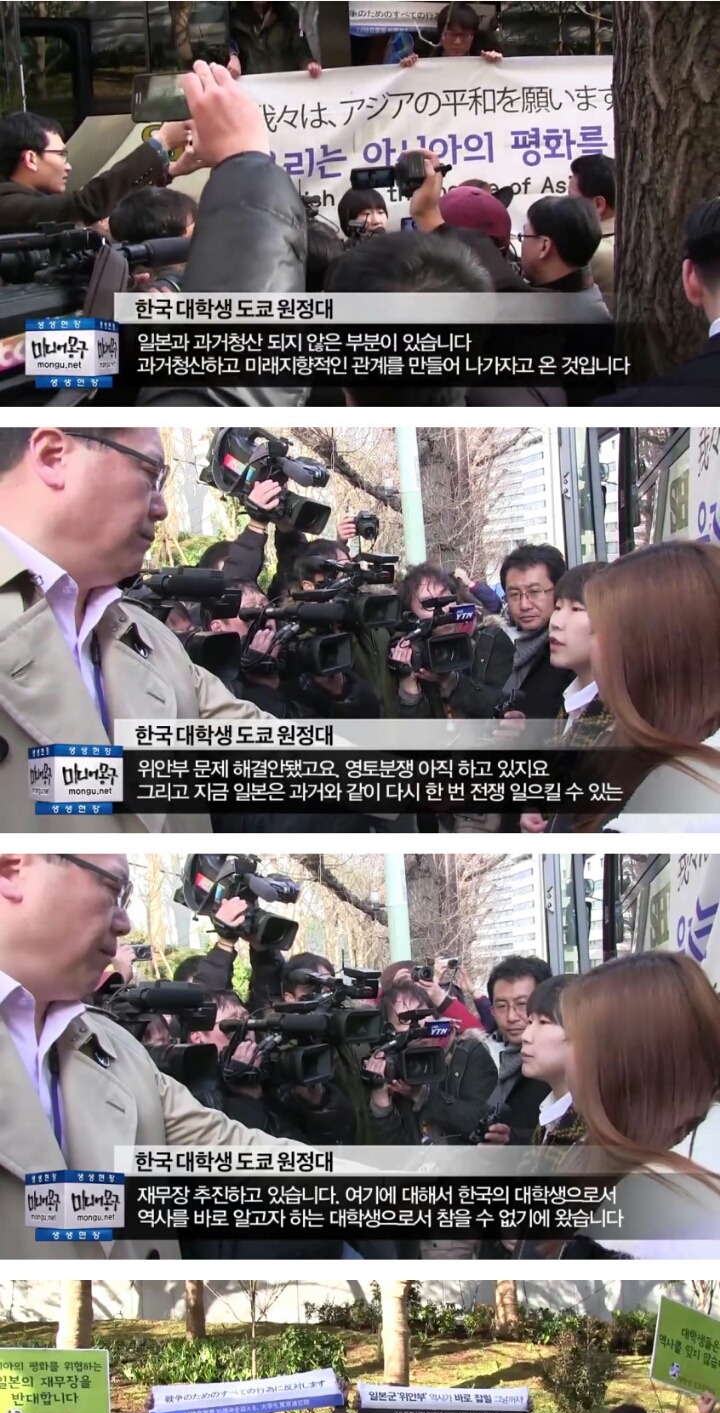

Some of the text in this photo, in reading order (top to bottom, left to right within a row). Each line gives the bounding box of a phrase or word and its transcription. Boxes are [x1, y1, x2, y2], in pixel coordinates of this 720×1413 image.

[270, 144, 347, 180] 리는
[510, 125, 609, 167] 평화를
[511, 176, 532, 195] of
[456, 612, 473, 620] YTN
[659, 1334, 720, 1370] 역사를 잊지 않습
[29, 1361, 60, 1373] 평화를
[64, 1361, 103, 1373] 위협하는
[40, 1375, 92, 1389] 재무장을
[11, 1392, 79, 1406] 반대합니다
[454, 1393, 472, 1403] 바로
[475, 1394, 492, 1404] 잡힐
